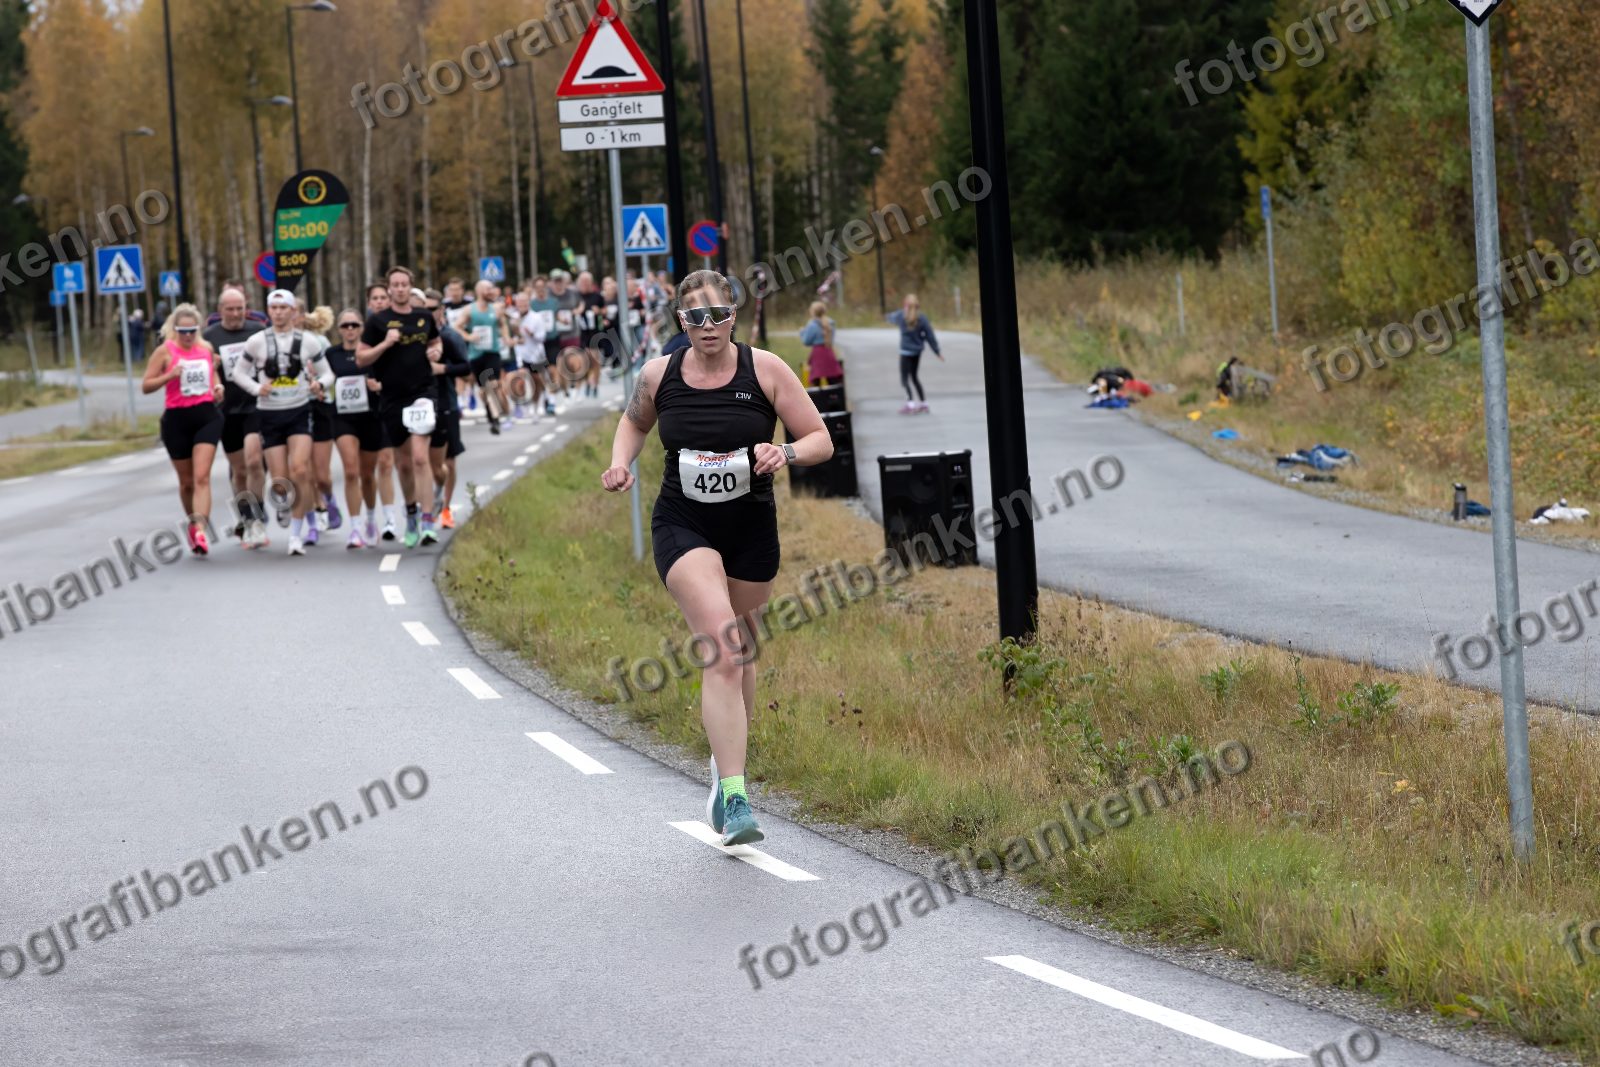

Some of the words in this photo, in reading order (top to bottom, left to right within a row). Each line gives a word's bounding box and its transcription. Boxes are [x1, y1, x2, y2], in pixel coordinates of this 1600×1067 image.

[580, 101, 642, 119] Gangfelt
[585, 131, 595, 145] 0
[610, 130, 616, 143] 1
[620, 130, 641, 143] km
[278, 220, 329, 240] 50:00
[279, 253, 308, 266] 5:00
[341, 388, 360, 400] 650
[409, 410, 428, 422] 737
[694, 472, 737, 493] 420
